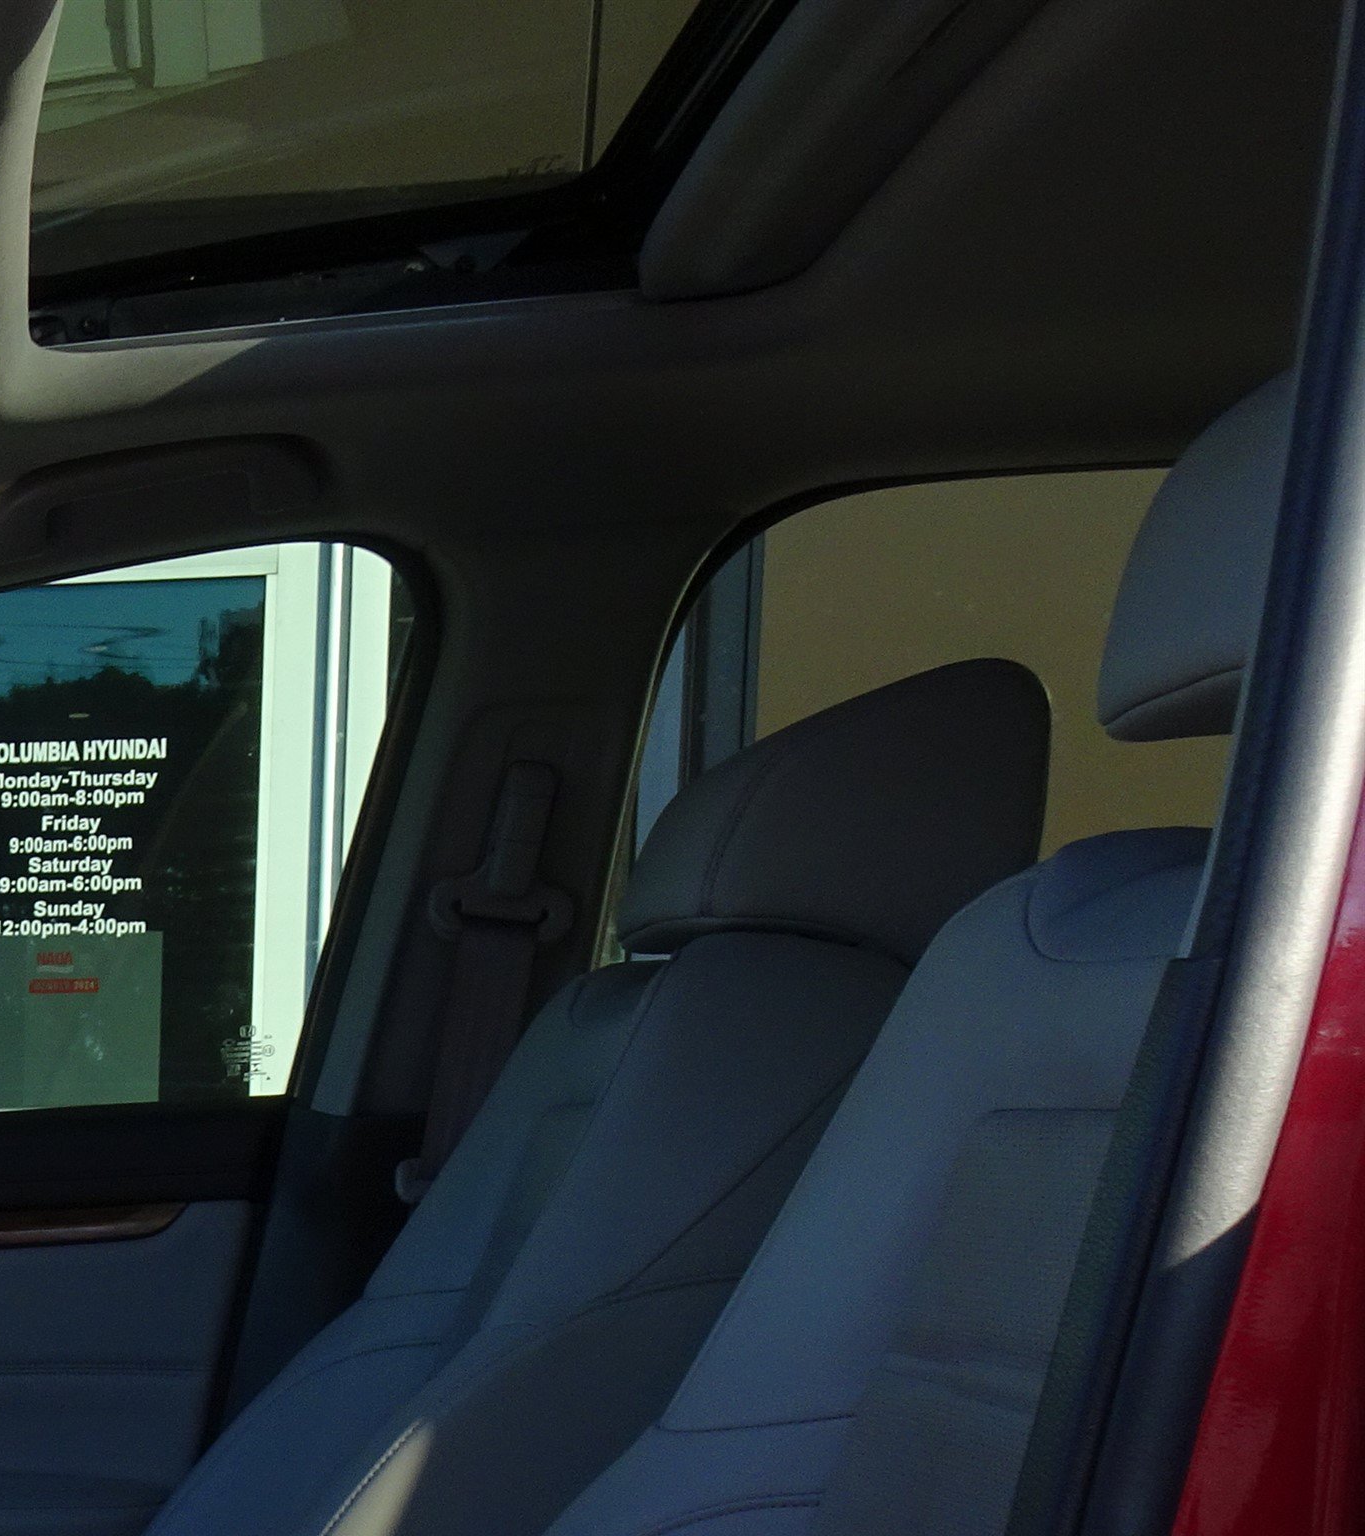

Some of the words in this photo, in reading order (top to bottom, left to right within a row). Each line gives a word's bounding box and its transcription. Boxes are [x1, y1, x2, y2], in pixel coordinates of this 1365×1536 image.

[83, 738, 167, 761] HYUNDAI
[1, 789, 145, 808] 9:00am-8:00pm
[41, 815, 101, 833] Friday
[9, 835, 132, 854] 9:00am-6:00pm
[28, 856, 113, 875] Saturday
[0, 876, 142, 894] 9:00am-6:00pm
[33, 900, 105, 919] Sunday
